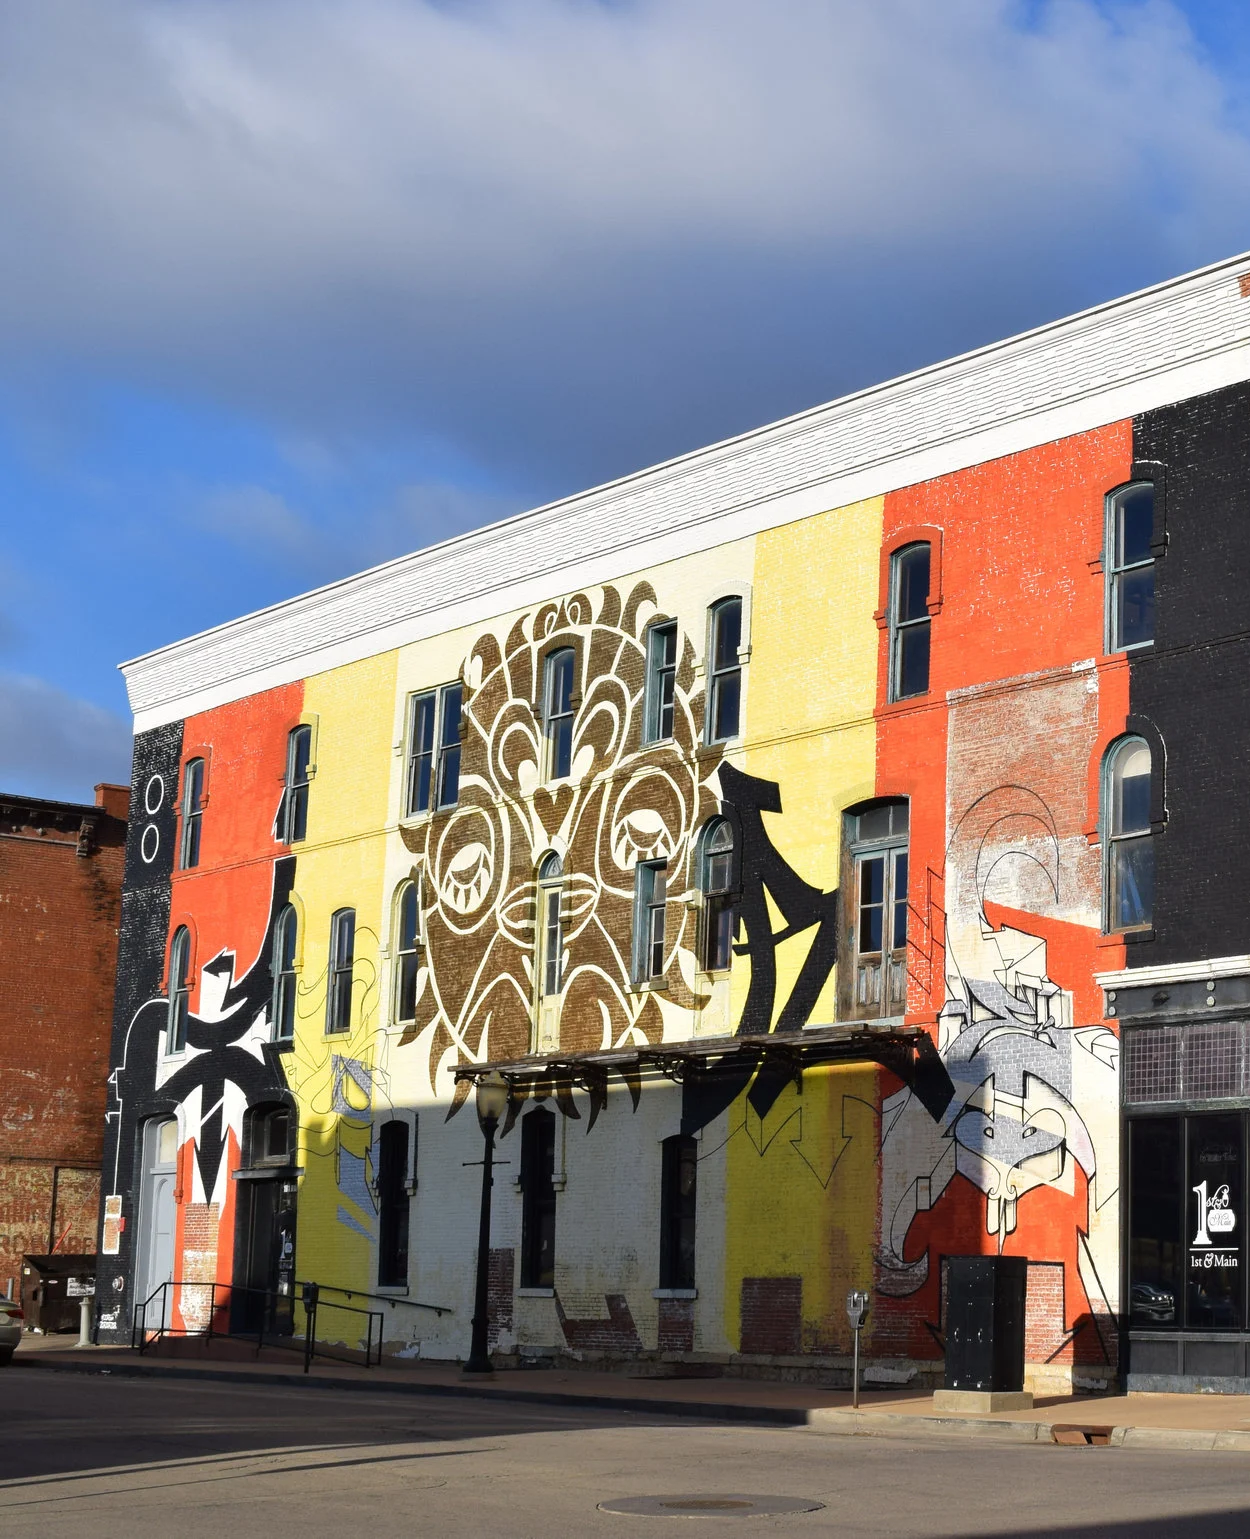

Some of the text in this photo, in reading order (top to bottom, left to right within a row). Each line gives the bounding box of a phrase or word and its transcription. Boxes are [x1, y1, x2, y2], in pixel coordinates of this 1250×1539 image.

[1191, 1252, 1238, 1268] 1st & Main
